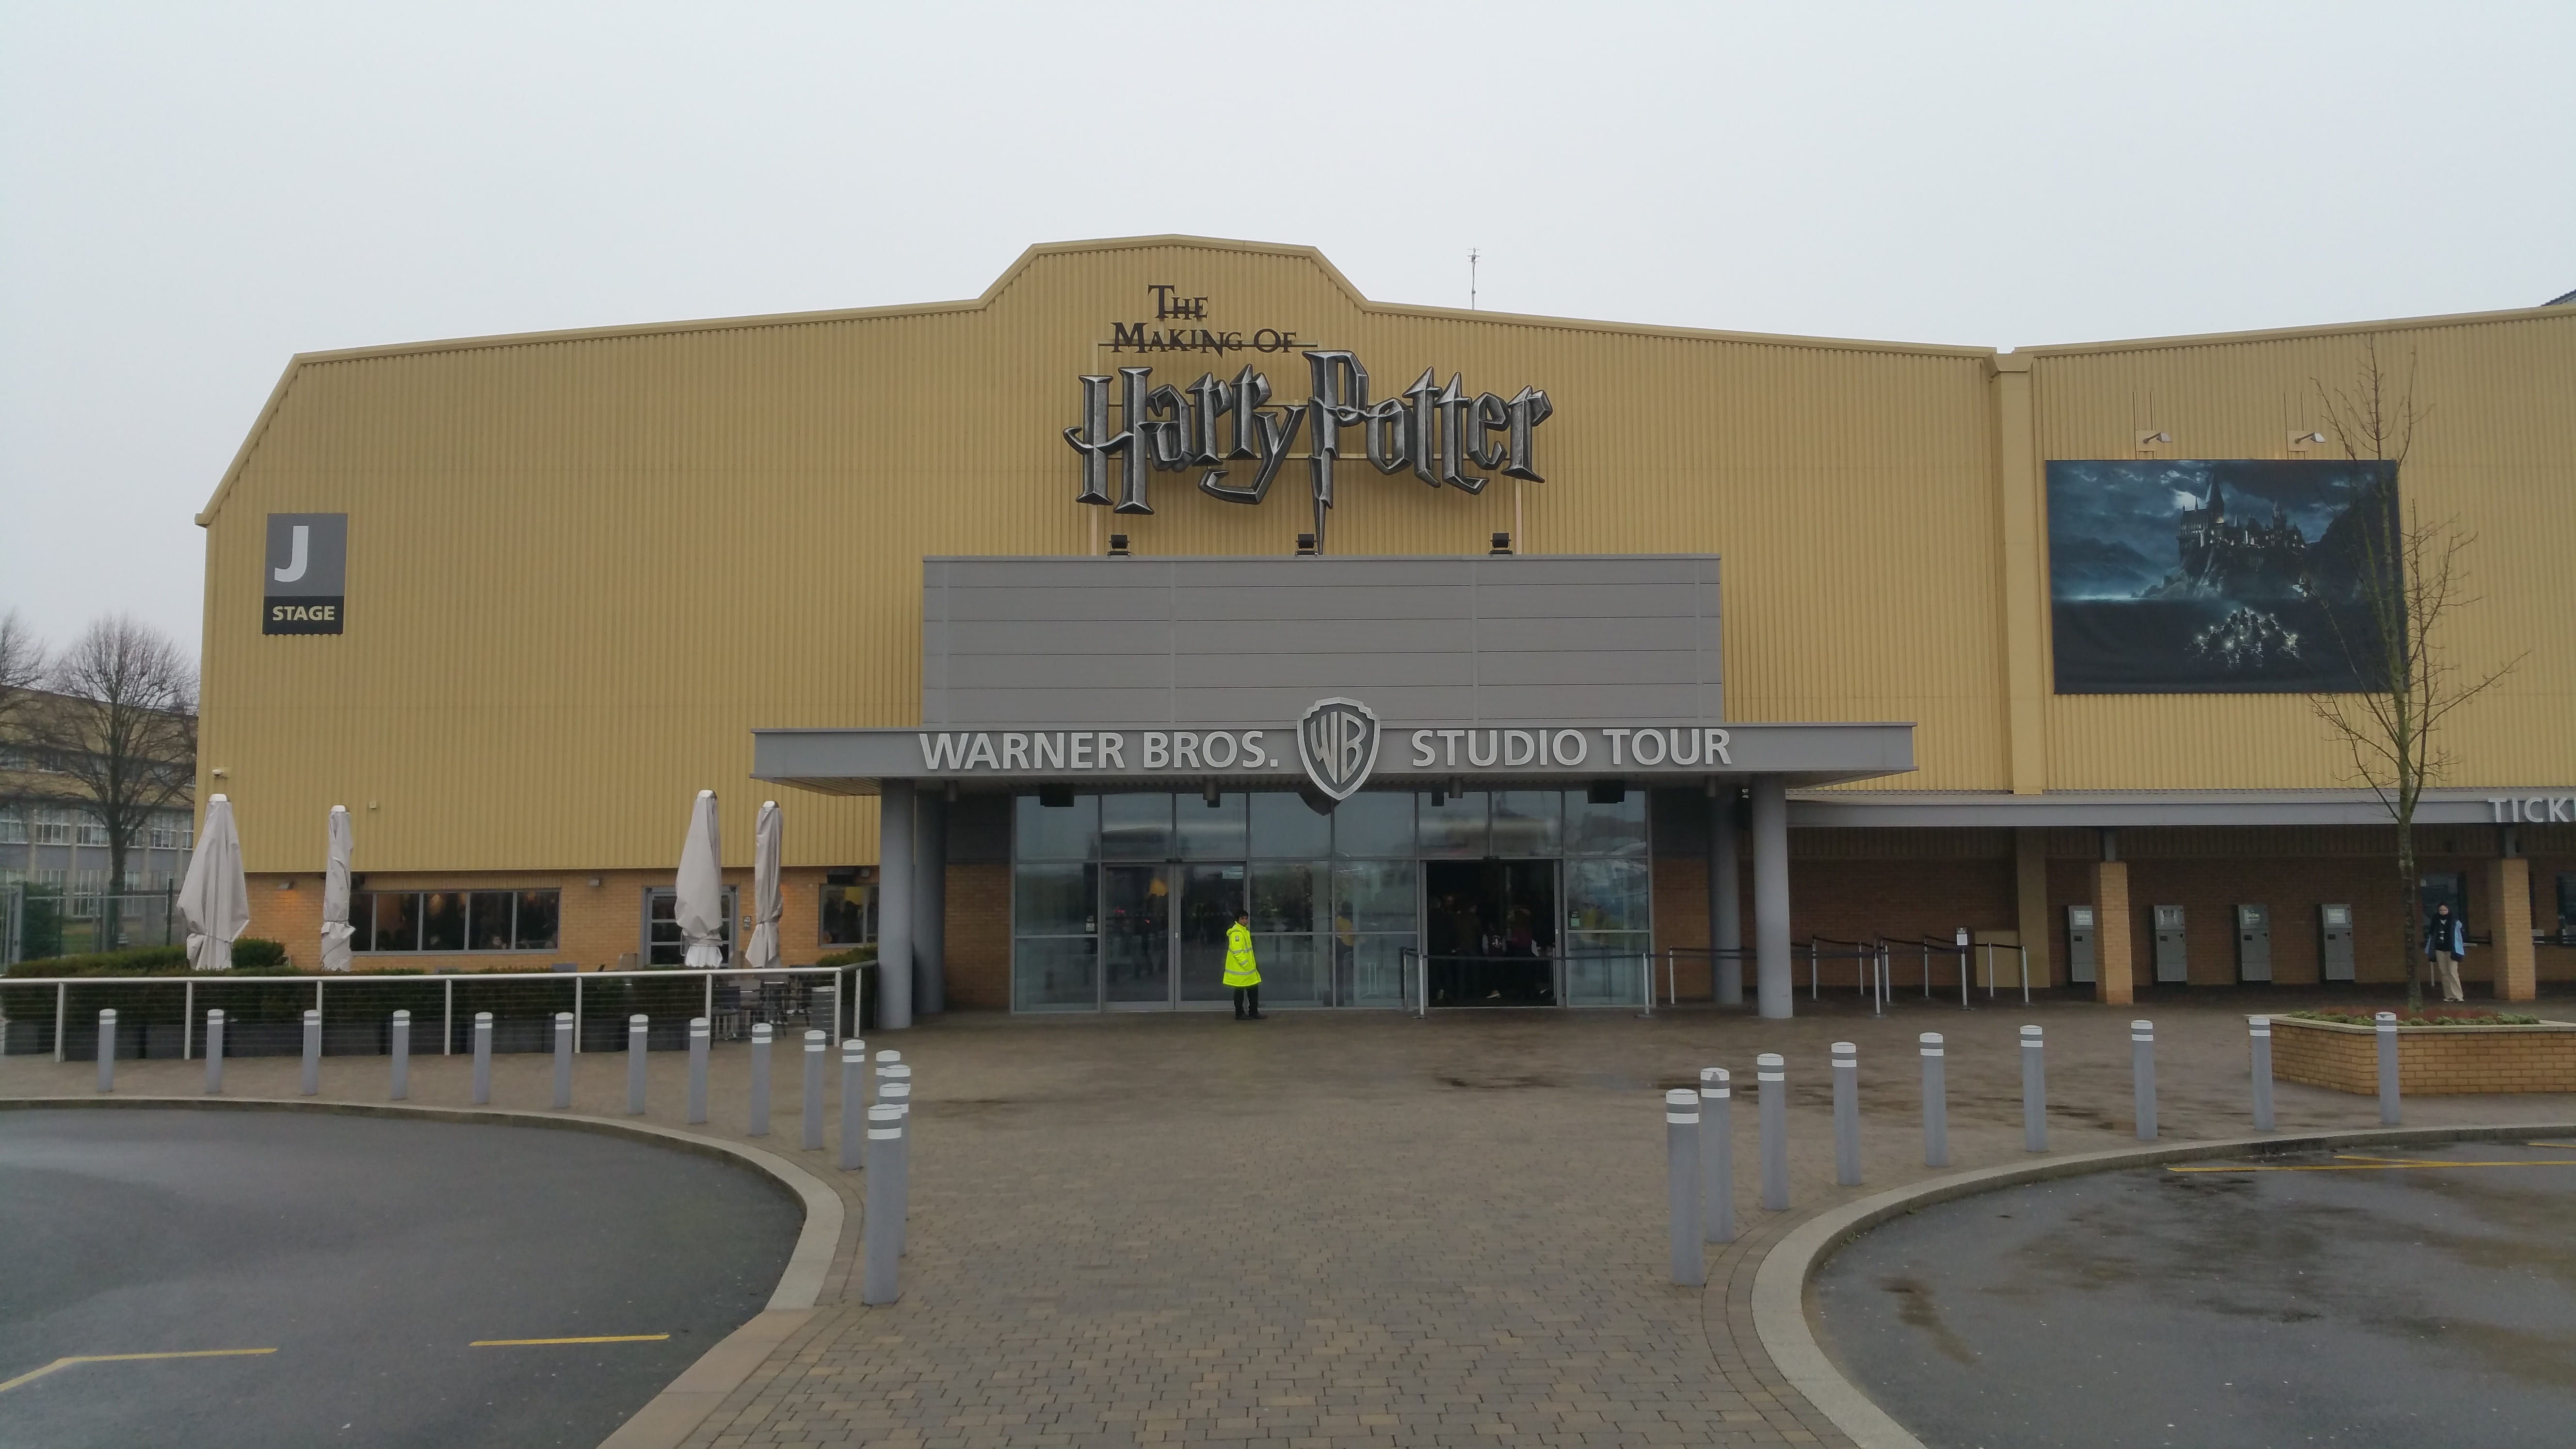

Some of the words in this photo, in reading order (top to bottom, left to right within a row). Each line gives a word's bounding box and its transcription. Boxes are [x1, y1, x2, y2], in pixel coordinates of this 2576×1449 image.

[1253, 328, 1297, 354] OF
[1063, 364, 1306, 515] Harry
[1302, 350, 1553, 555] Potter
[274, 525, 309, 582] J
[273, 606, 335, 621] STAGE
[919, 732, 1126, 770] WARNER
[1143, 731, 1278, 769] BROS.
[1310, 711, 1367, 785] WB
[1412, 729, 1588, 767] STUDIO
[1602, 728, 1732, 765] TOUR
[2488, 797, 2576, 822] TICK
